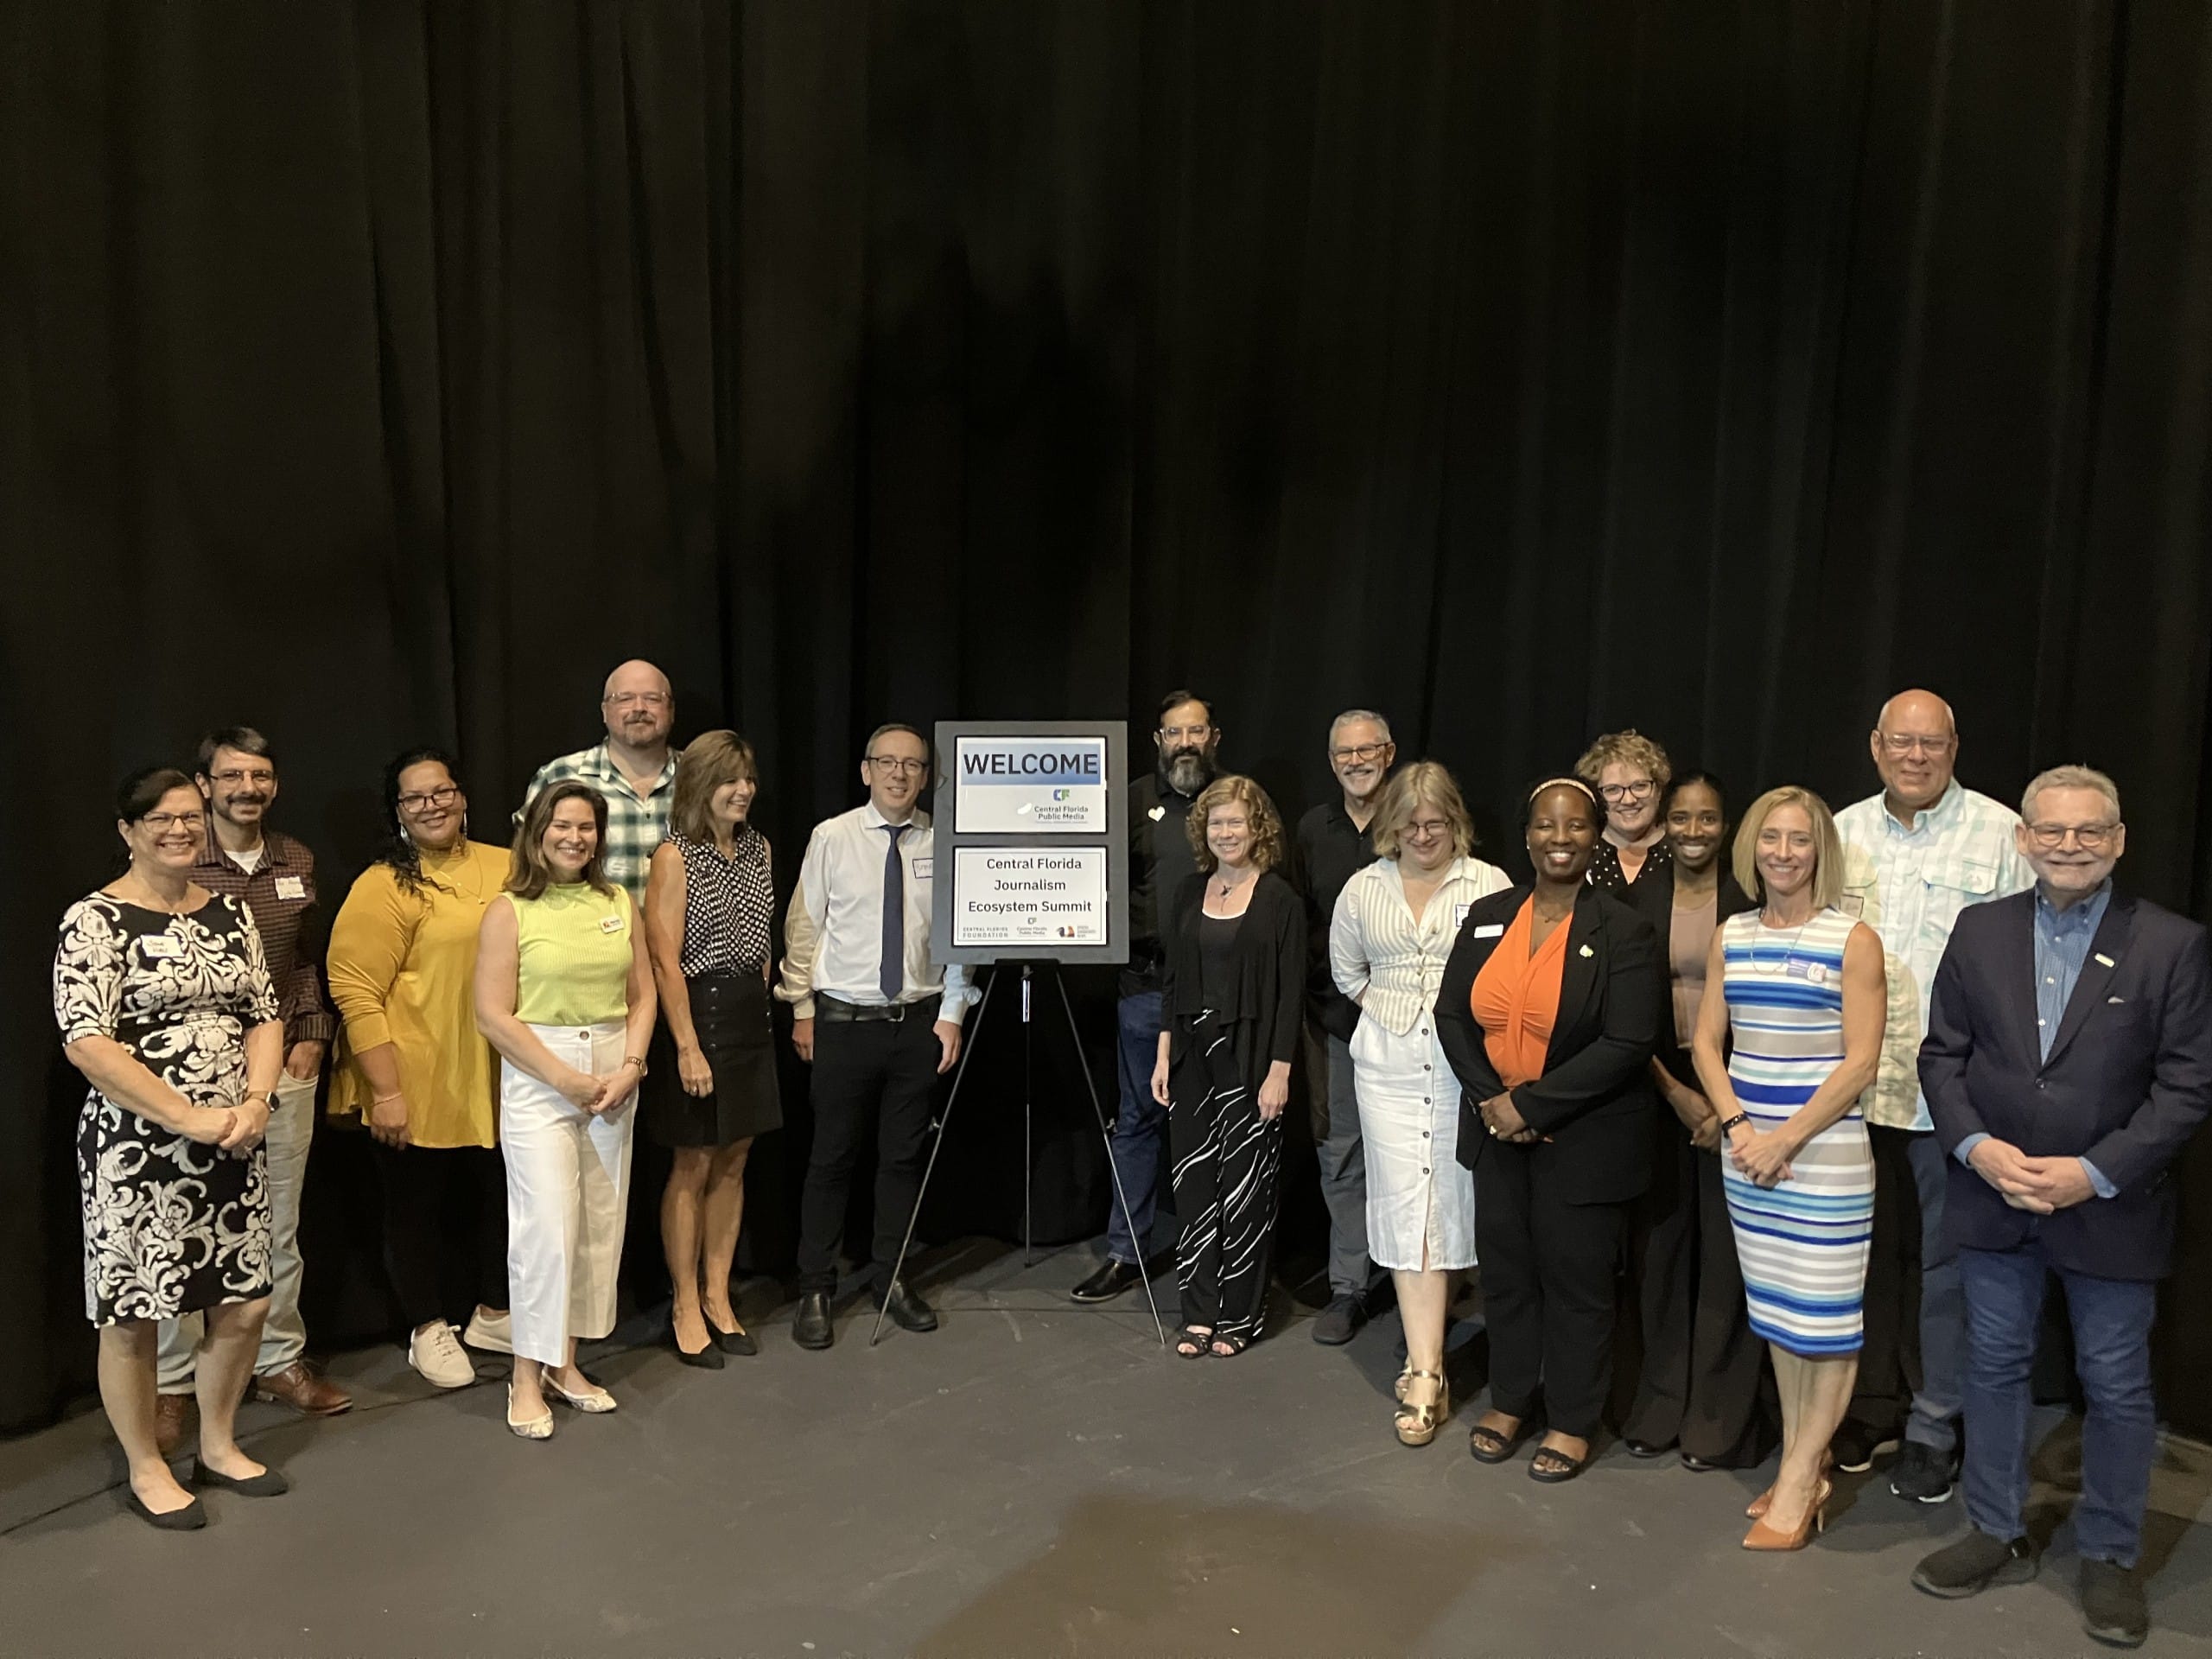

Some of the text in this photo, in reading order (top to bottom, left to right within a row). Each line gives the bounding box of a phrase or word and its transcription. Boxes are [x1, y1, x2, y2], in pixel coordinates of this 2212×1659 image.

[963, 753, 1098, 775] WELCOME
[987, 858, 1082, 869] Central Florida
[994, 878, 1066, 891] Journalism
[969, 900, 1092, 914] Ecosystem Summit
